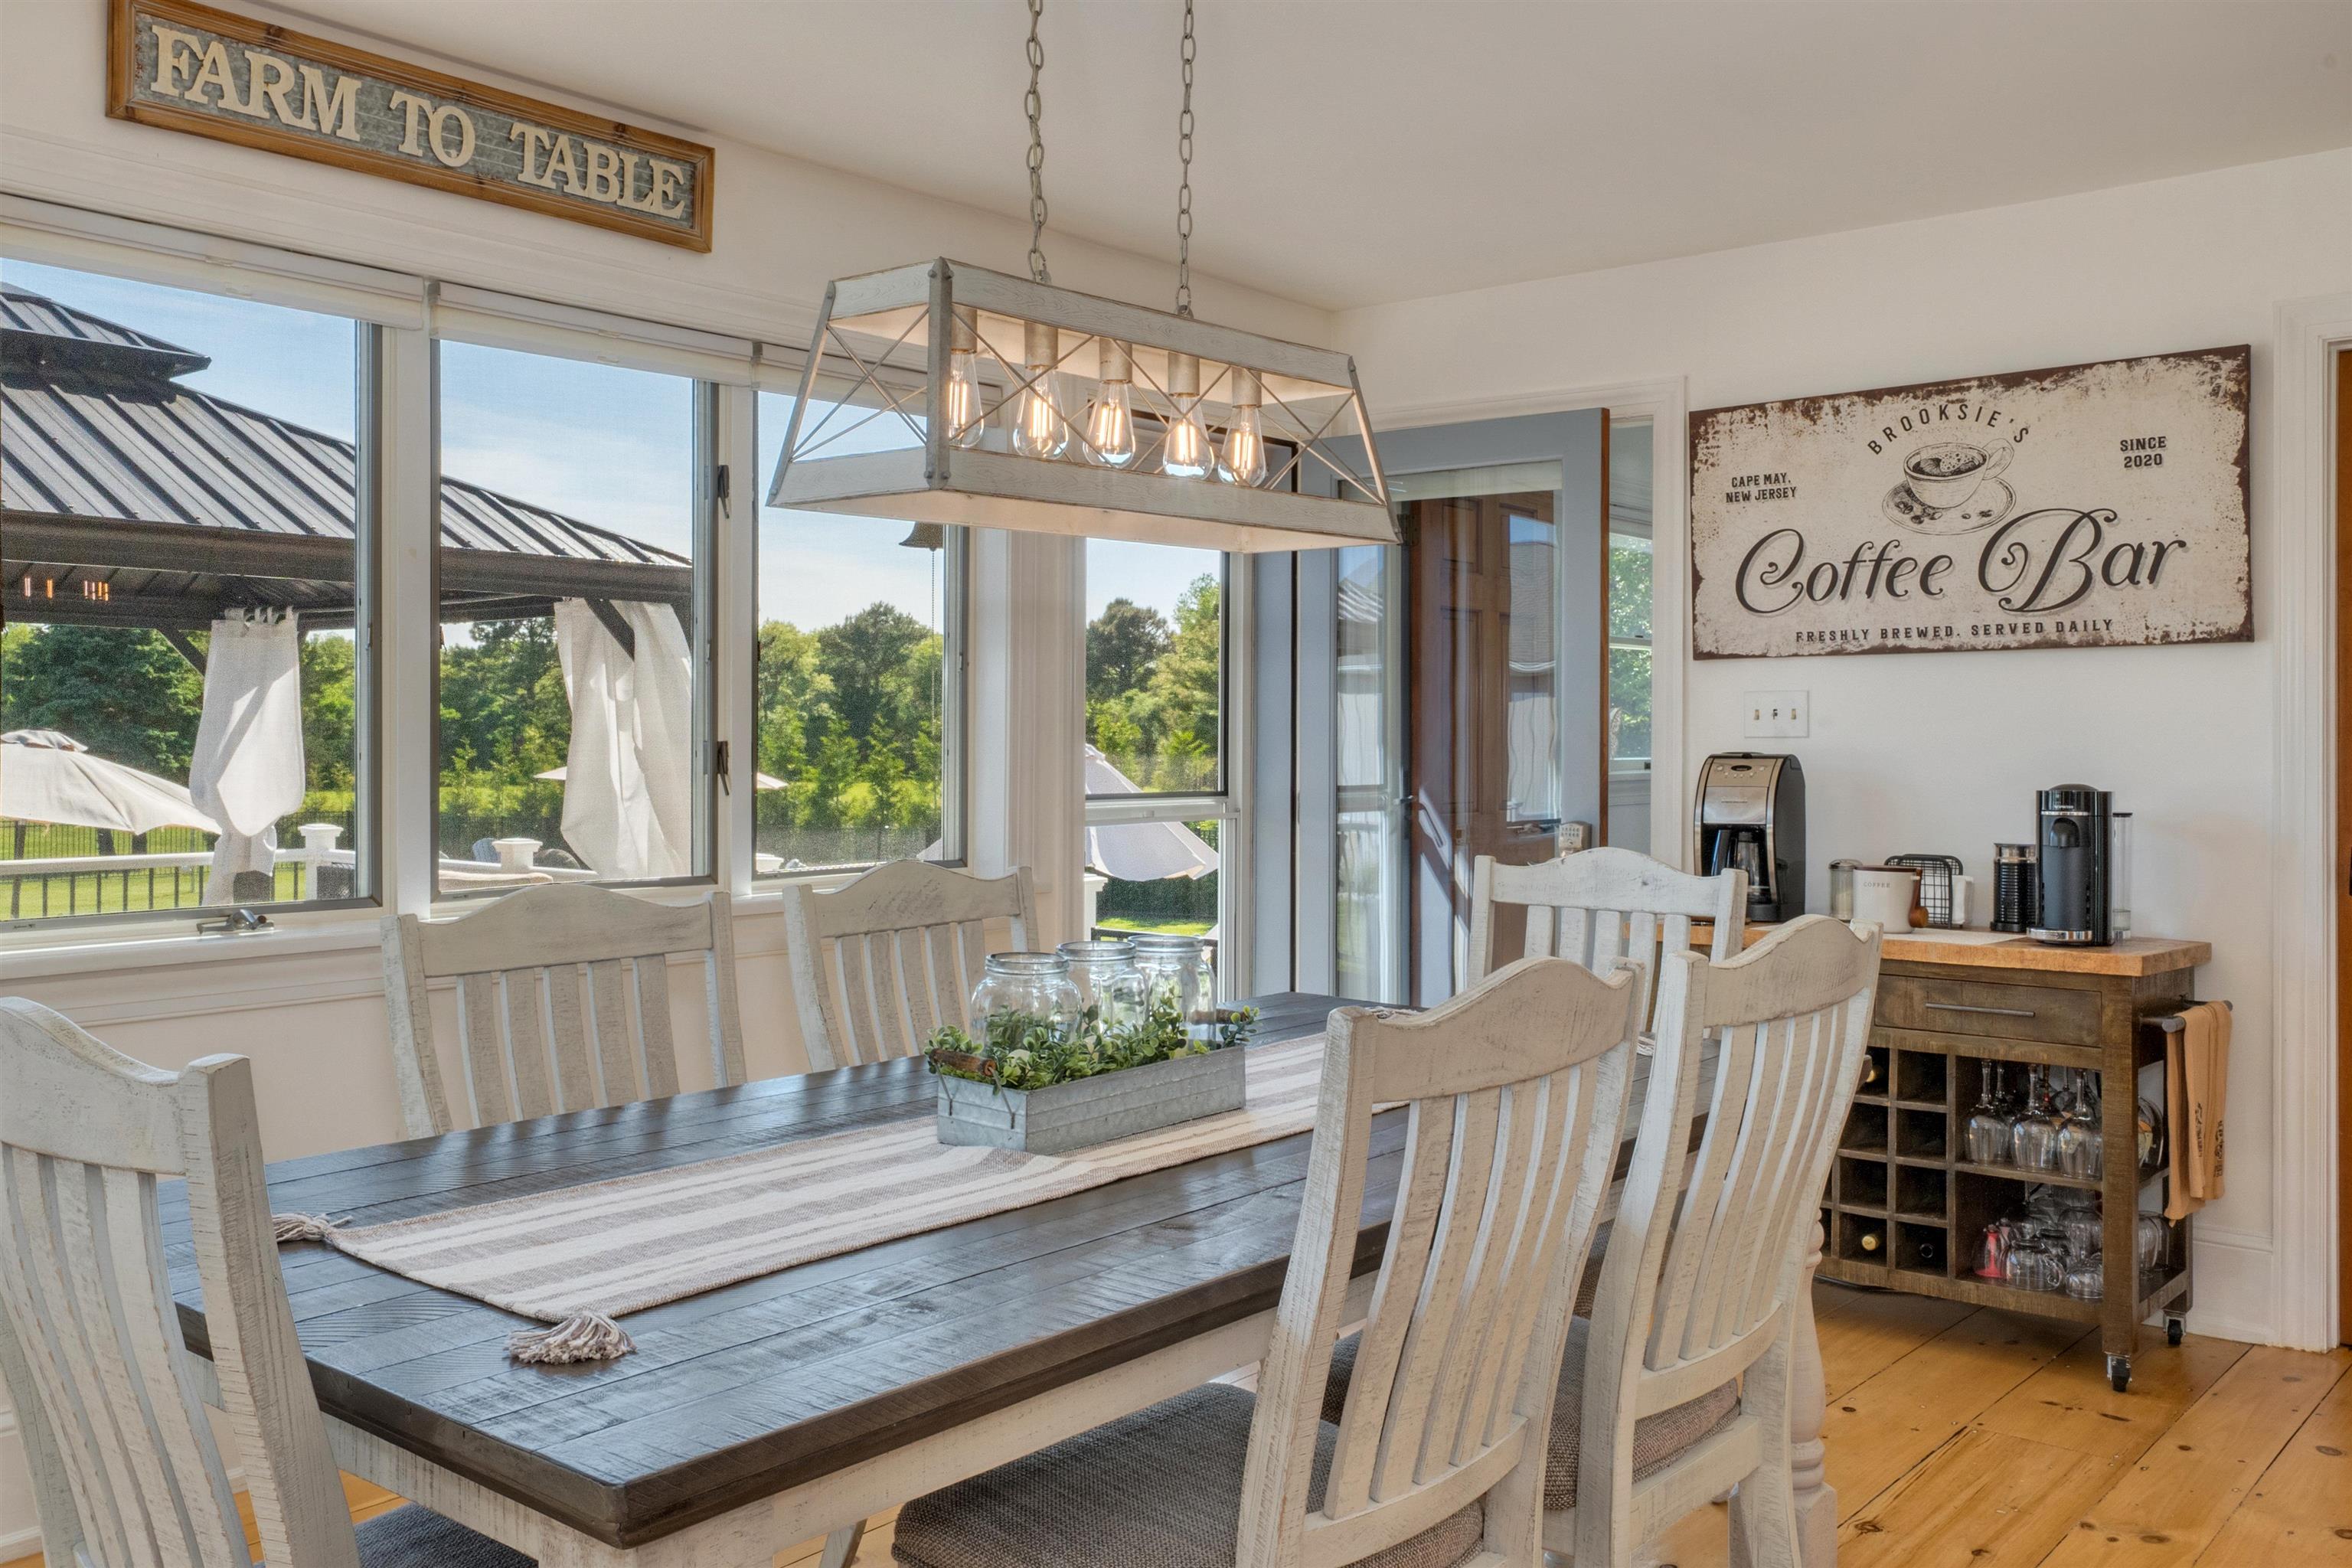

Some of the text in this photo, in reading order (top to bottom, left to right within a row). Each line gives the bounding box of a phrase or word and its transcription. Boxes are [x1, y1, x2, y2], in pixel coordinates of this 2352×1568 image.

[150, 24, 686, 220] FARM TO TABLE
[1867, 403, 2030, 455] BROOKSIE'S
[2119, 436, 2167, 452] SINCE
[2123, 452, 2163, 469] 2020
[1731, 475, 1760, 488] CAPE
[1726, 486, 1796, 502] NEW JERSEY
[1735, 507, 2187, 615] Coffee Bar
[1795, 629, 1870, 642] FRESHLY
[1971, 622, 2044, 636] SERVED
[2056, 619, 2114, 633] DAILY
